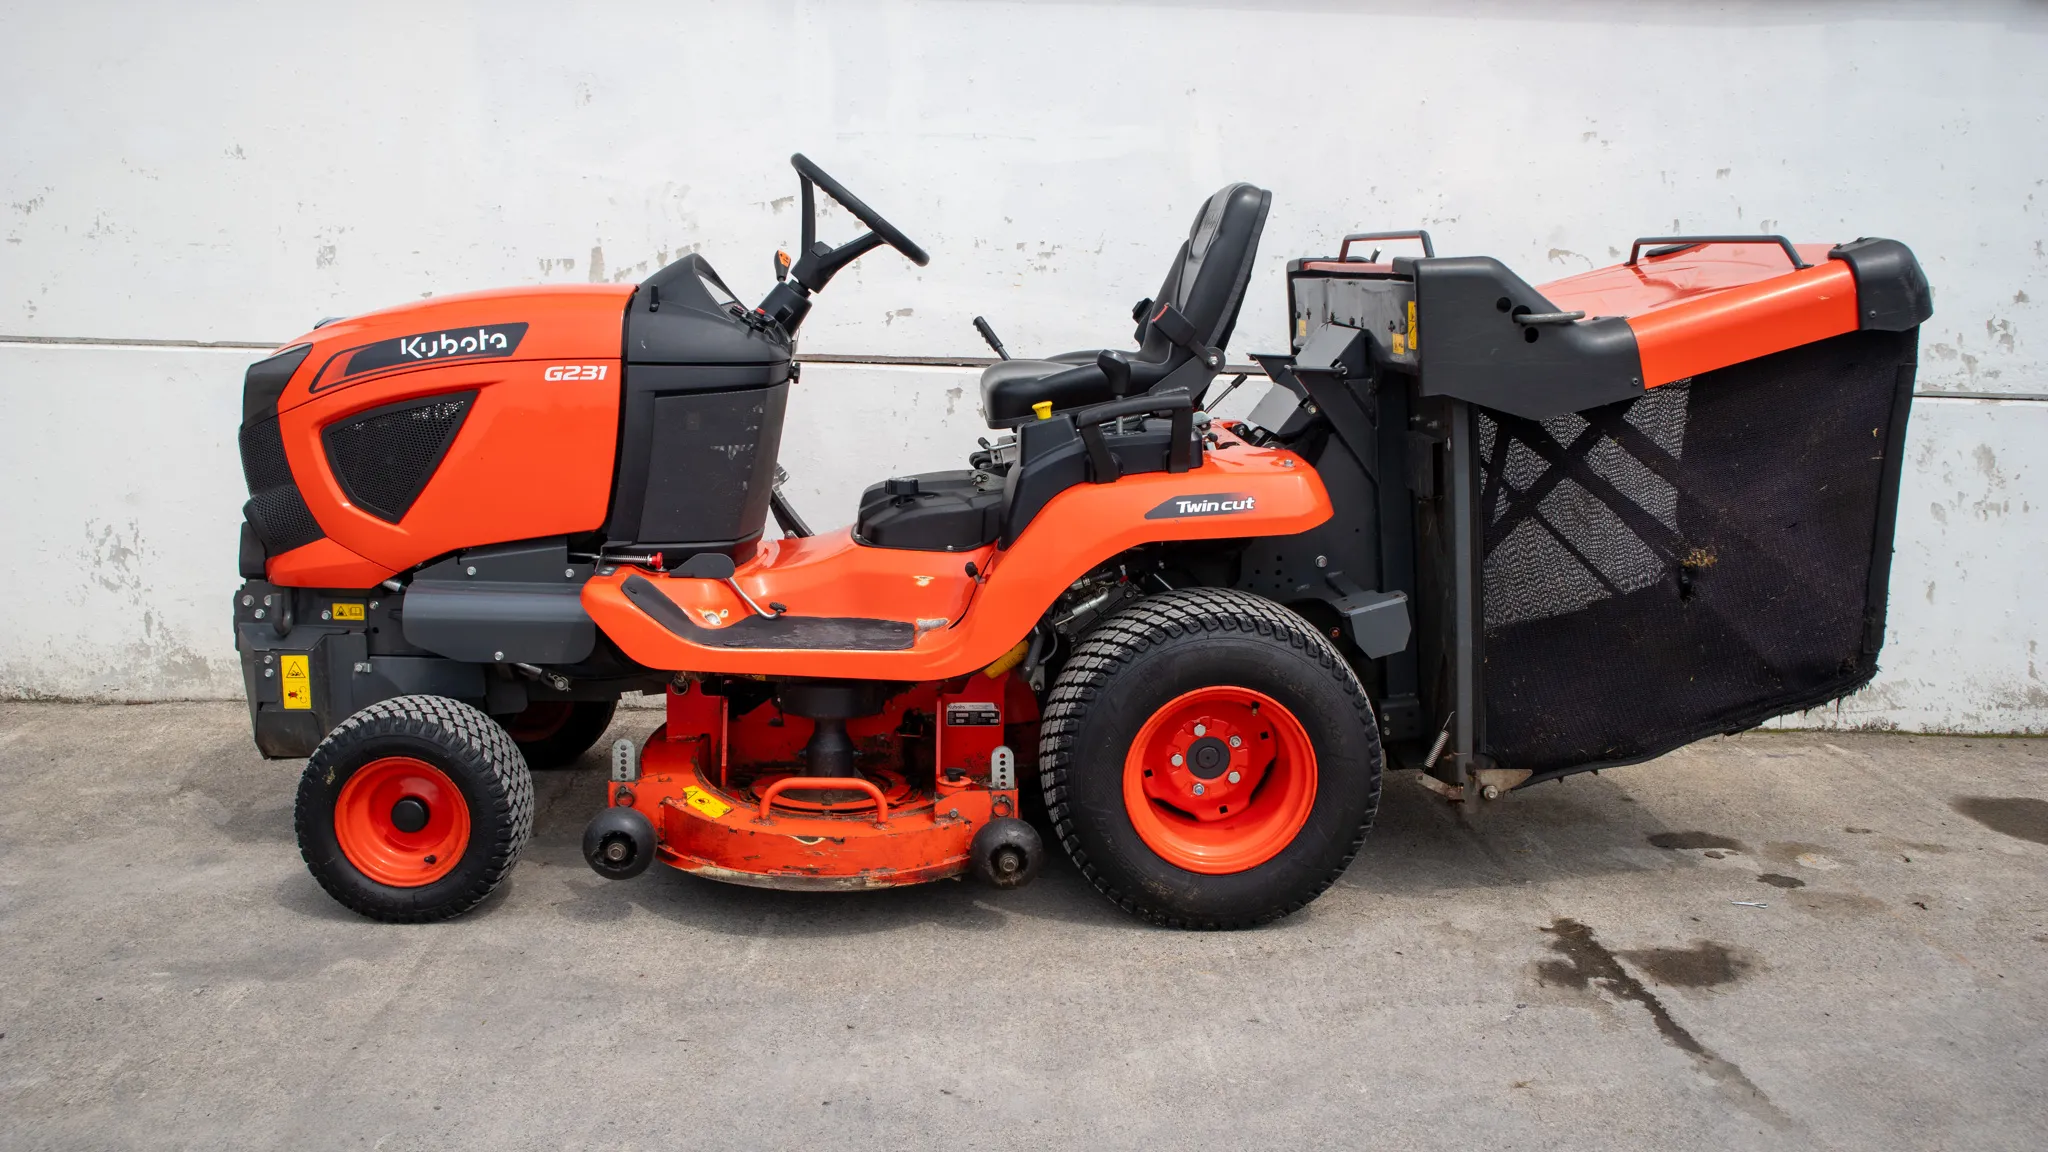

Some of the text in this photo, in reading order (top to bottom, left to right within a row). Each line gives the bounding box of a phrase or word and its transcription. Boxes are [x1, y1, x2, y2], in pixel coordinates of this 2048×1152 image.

[400, 329, 508, 358] Kubota
[544, 365, 608, 382] G231
[1176, 496, 1255, 513] Twin cut
